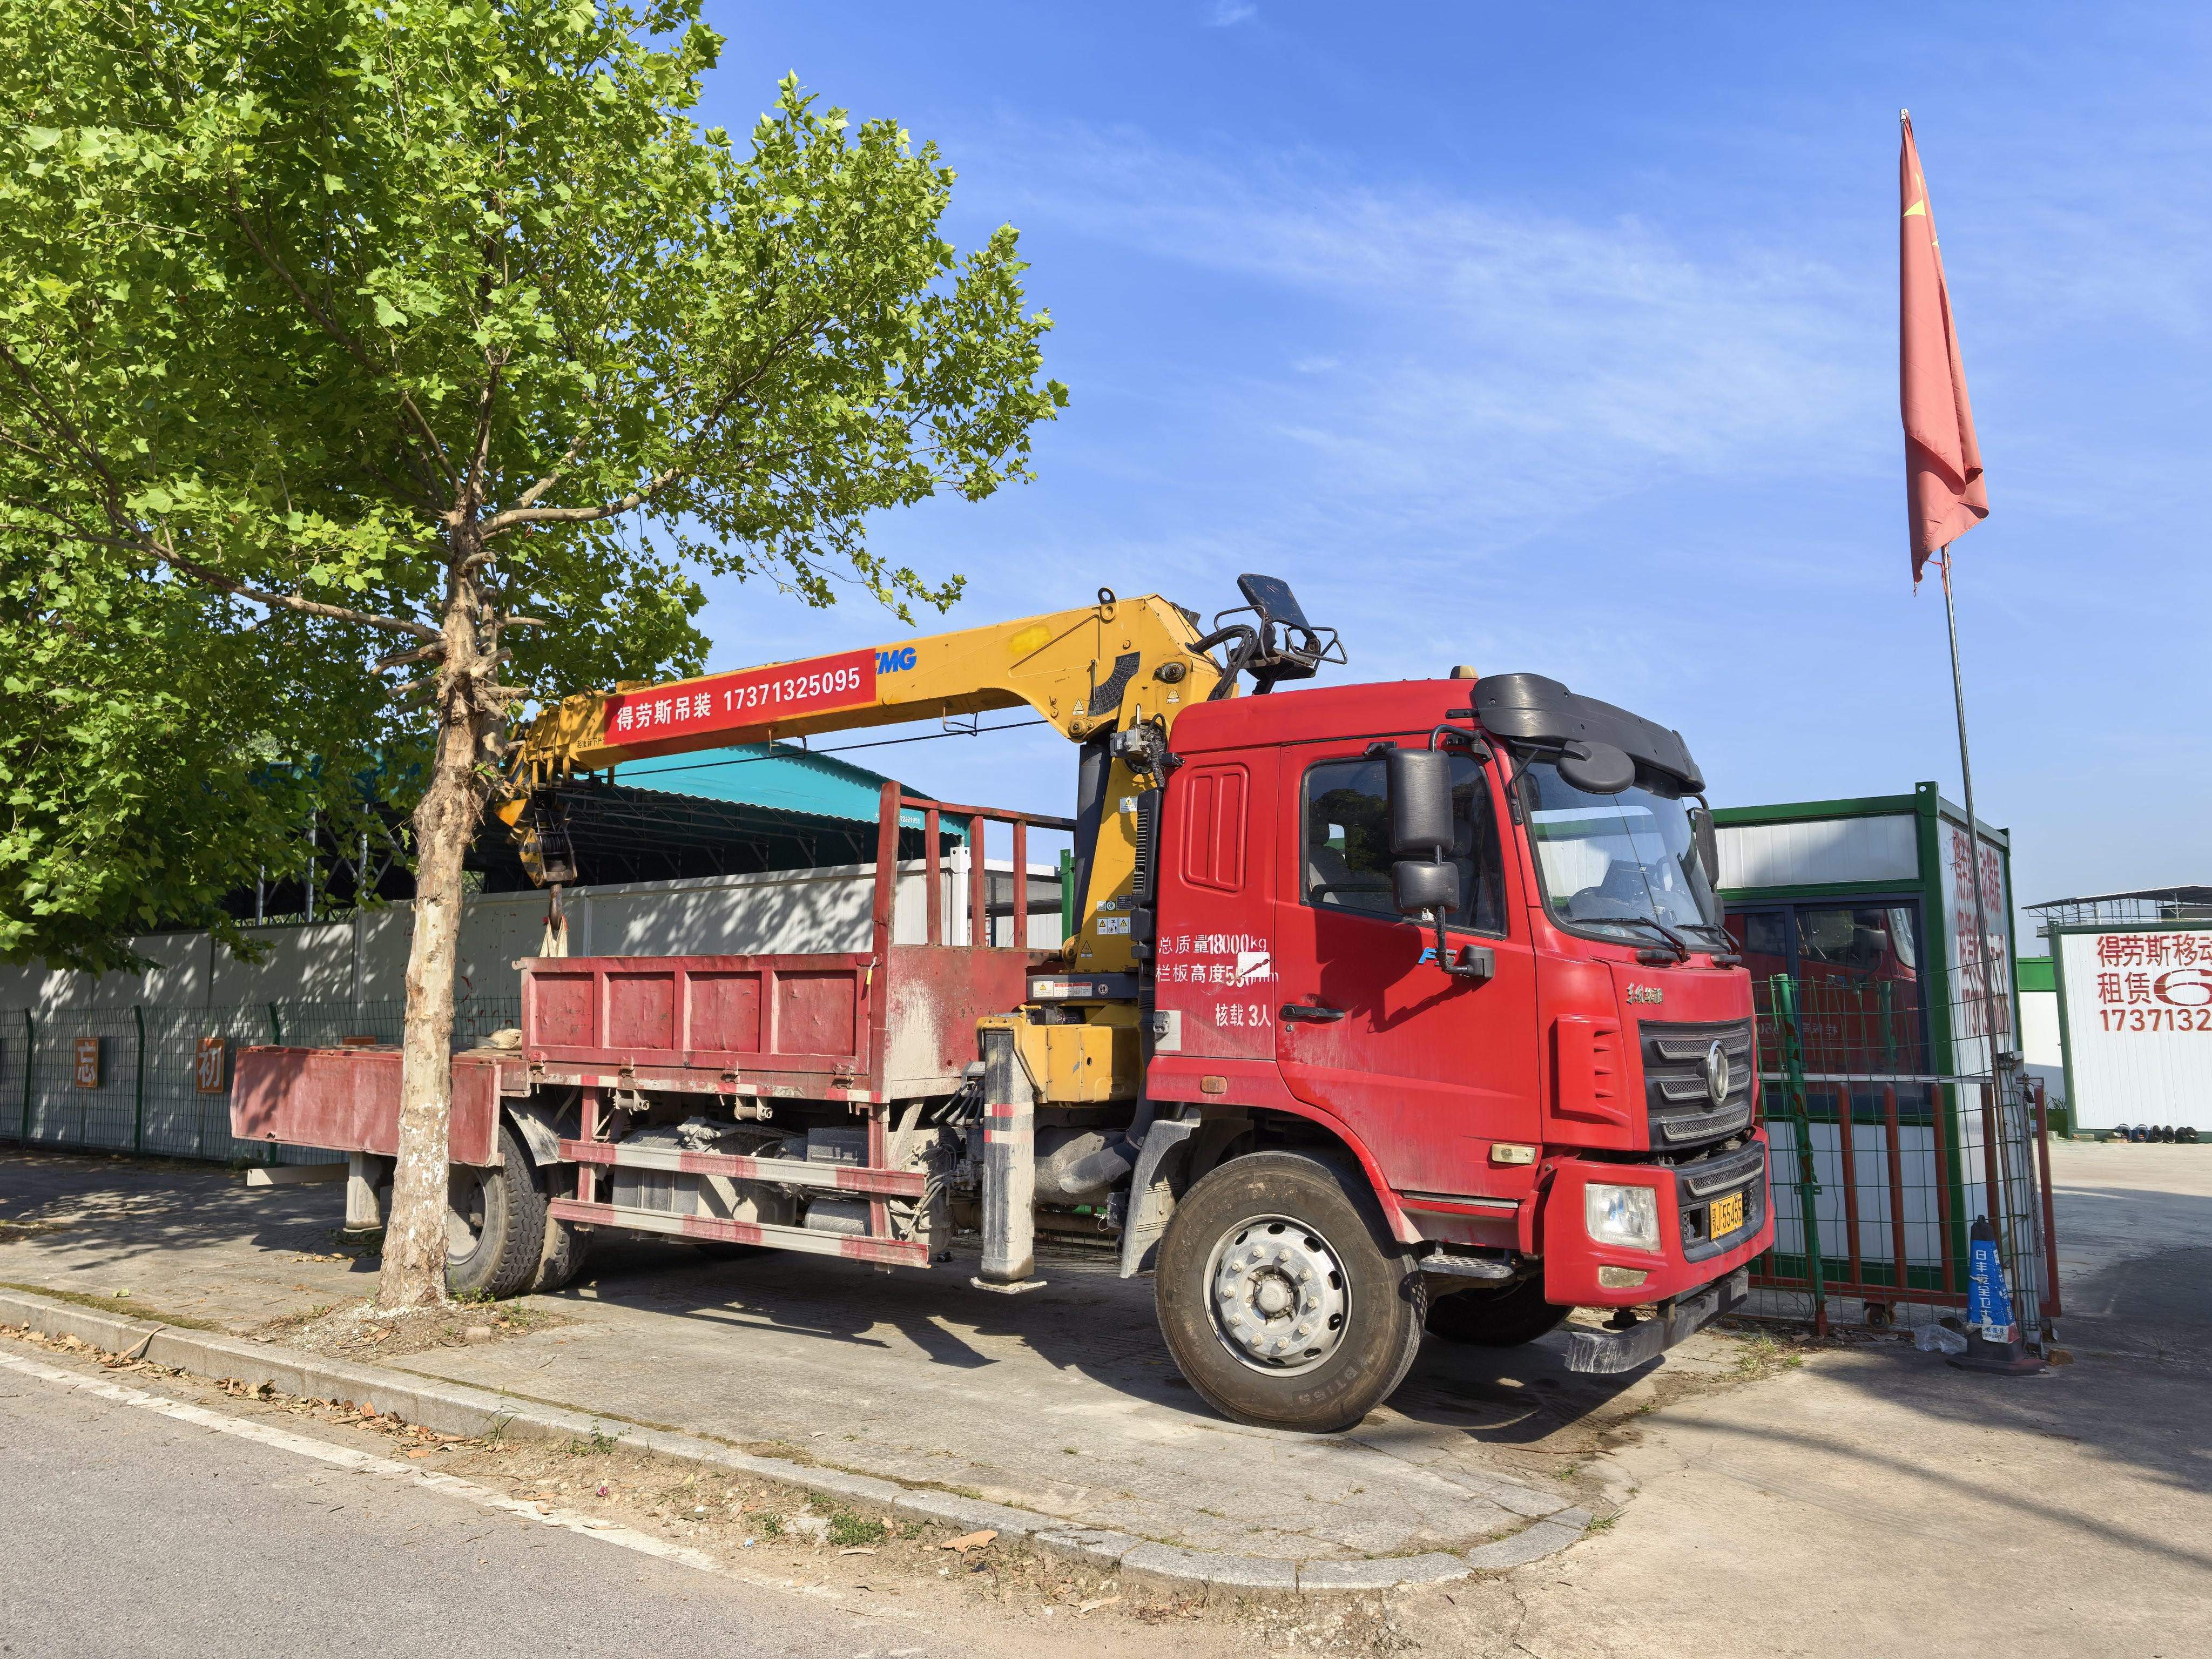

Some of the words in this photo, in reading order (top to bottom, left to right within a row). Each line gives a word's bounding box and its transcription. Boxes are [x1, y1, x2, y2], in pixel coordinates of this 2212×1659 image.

[875, 646, 916, 675] MG
[617, 692, 711, 732] 得劳斯吊装
[724, 667, 860, 711] 17371325095
[2100, 1009, 2212, 1031] 1737132
[77, 1041, 96, 1083] 忘
[198, 1044, 223, 1088] 初
